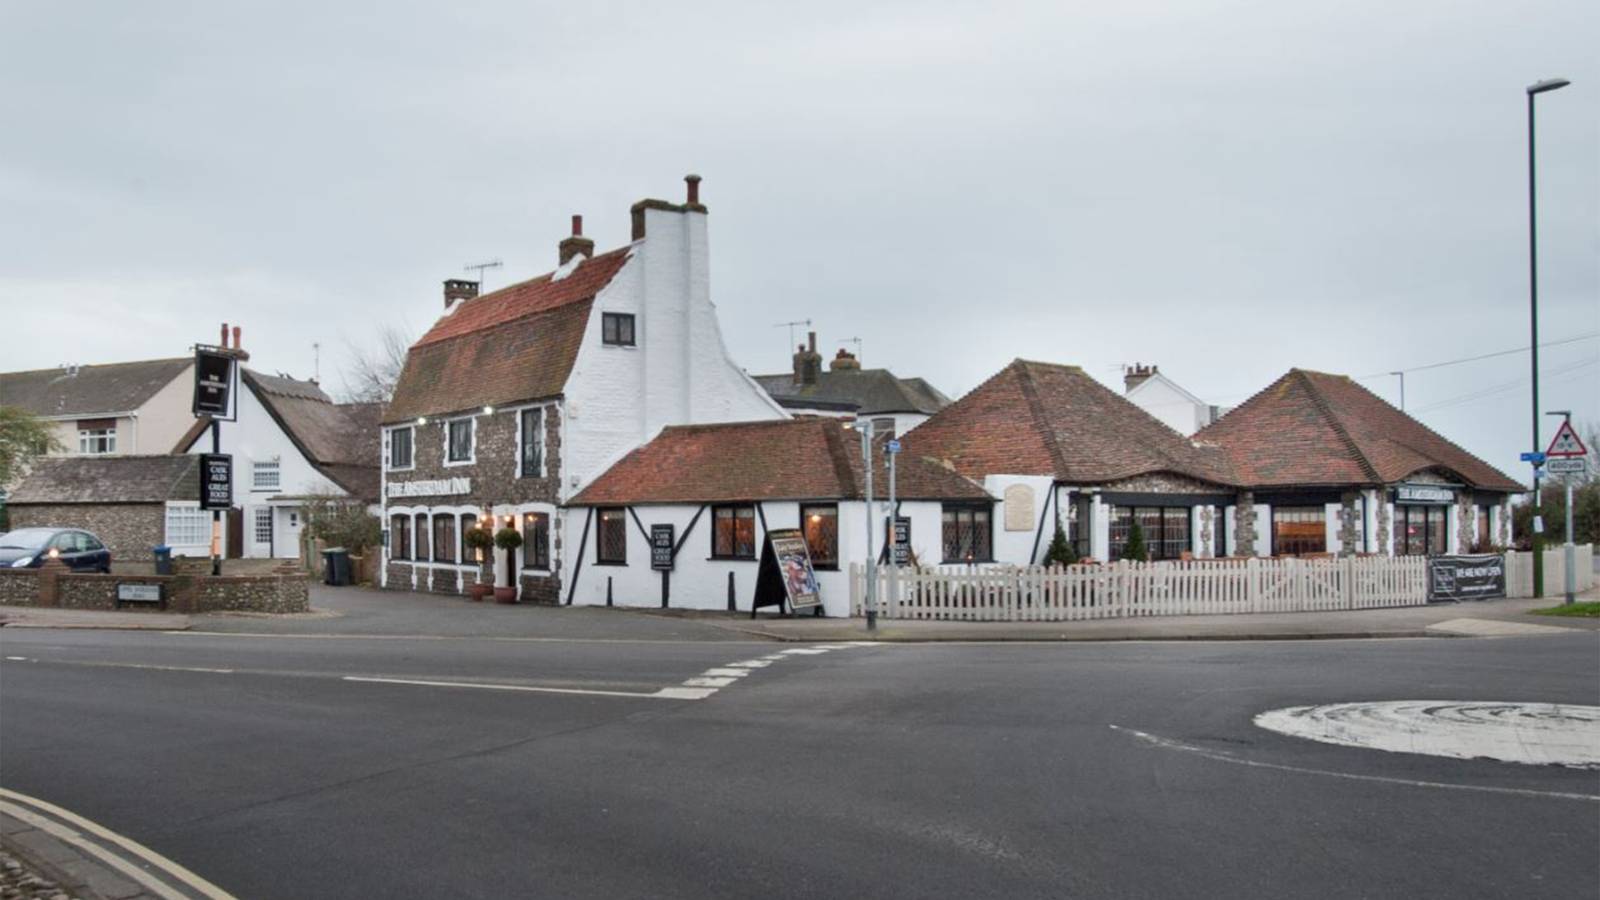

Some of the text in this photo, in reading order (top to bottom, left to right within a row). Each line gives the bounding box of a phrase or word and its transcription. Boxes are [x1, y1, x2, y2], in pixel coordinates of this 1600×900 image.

[209, 466, 228, 474] CASK
[210, 474, 227, 482] ALES
[208, 483, 229, 491] GREAT
[209, 491, 228, 499] FOOD
